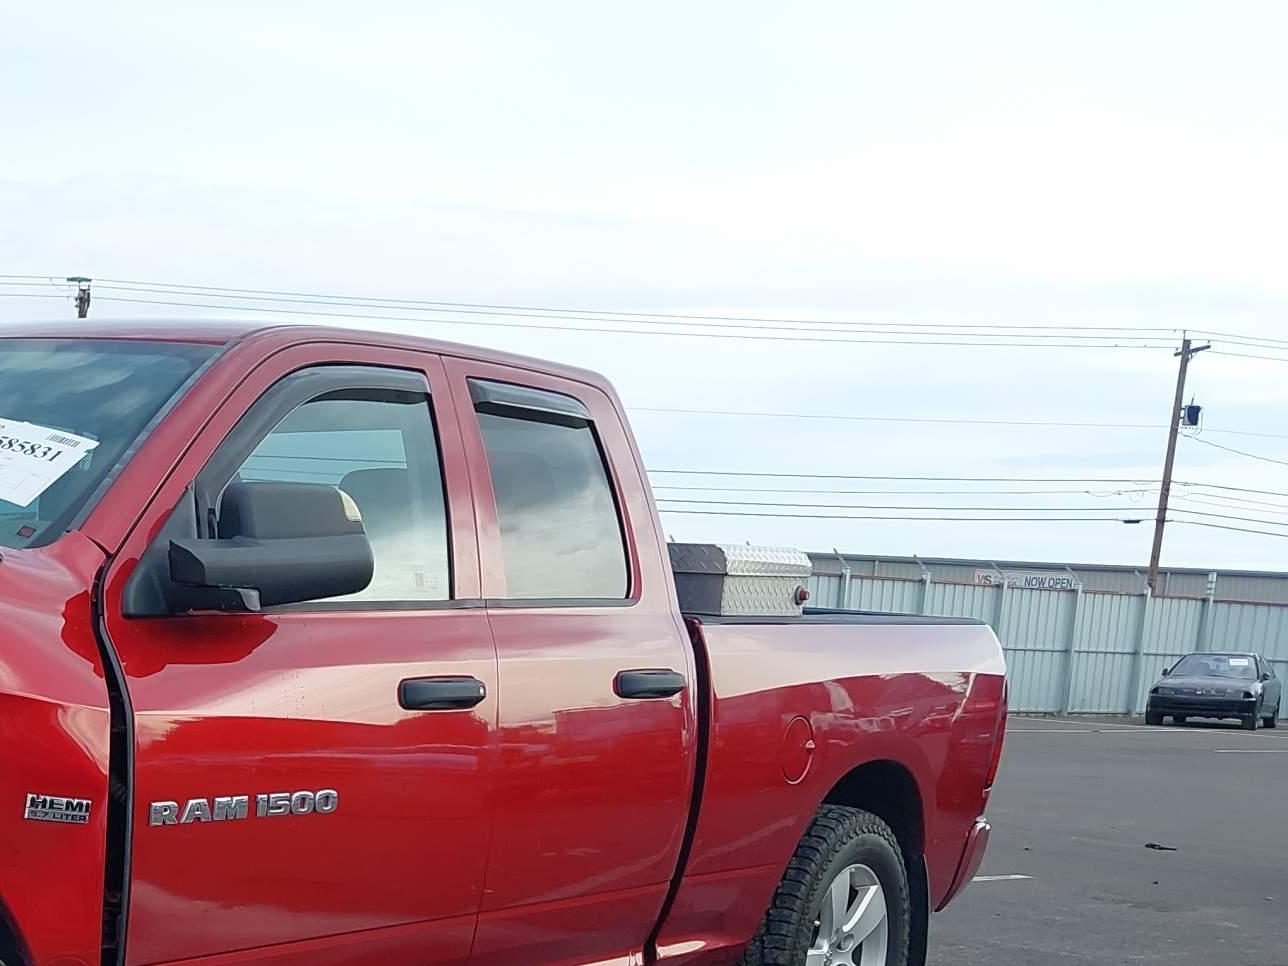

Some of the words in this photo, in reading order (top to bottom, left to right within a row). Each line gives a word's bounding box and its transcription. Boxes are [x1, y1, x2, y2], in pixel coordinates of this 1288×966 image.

[1024, 575, 1047, 588] NOW
[1048, 577, 1074, 589] OPEN
[28, 795, 91, 814] HEMI
[149, 795, 249, 827] RAM
[255, 788, 339, 817] 1500
[29, 810, 50, 819] 5.7
[52, 812, 88, 823] LITER
